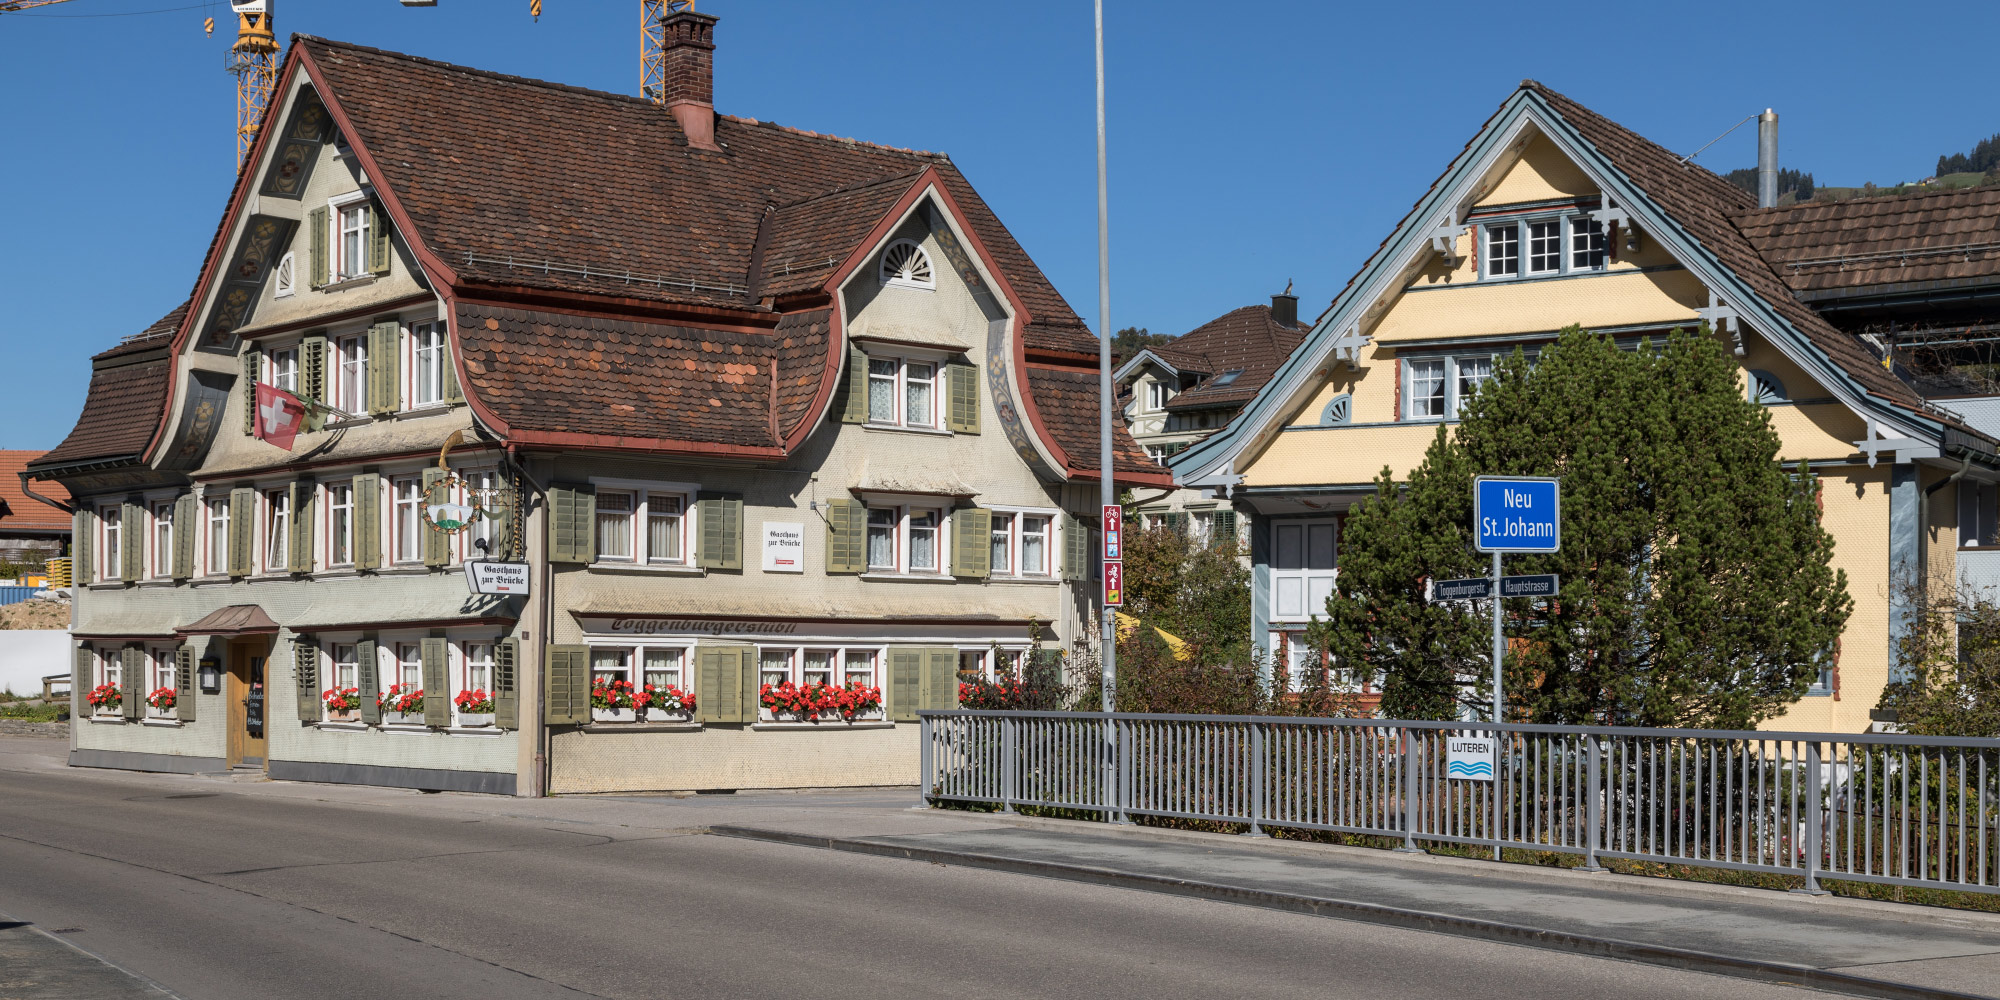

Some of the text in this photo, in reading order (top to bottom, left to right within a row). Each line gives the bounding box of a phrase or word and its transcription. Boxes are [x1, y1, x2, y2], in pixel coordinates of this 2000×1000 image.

[1504, 488, 1532, 508] Neu
[770, 530, 799, 539] Gasthaus
[779, 539, 801, 547] Brücke
[484, 565, 522, 575] Gasthaus
[481, 576, 525, 585] zur Brücke
[1439, 579, 1549, 598] Toggenburgerstr. Hauptstrasse
[611, 618, 797, 635] Toggenburgerstübli
[1452, 742, 1489, 753] LUTEREN
